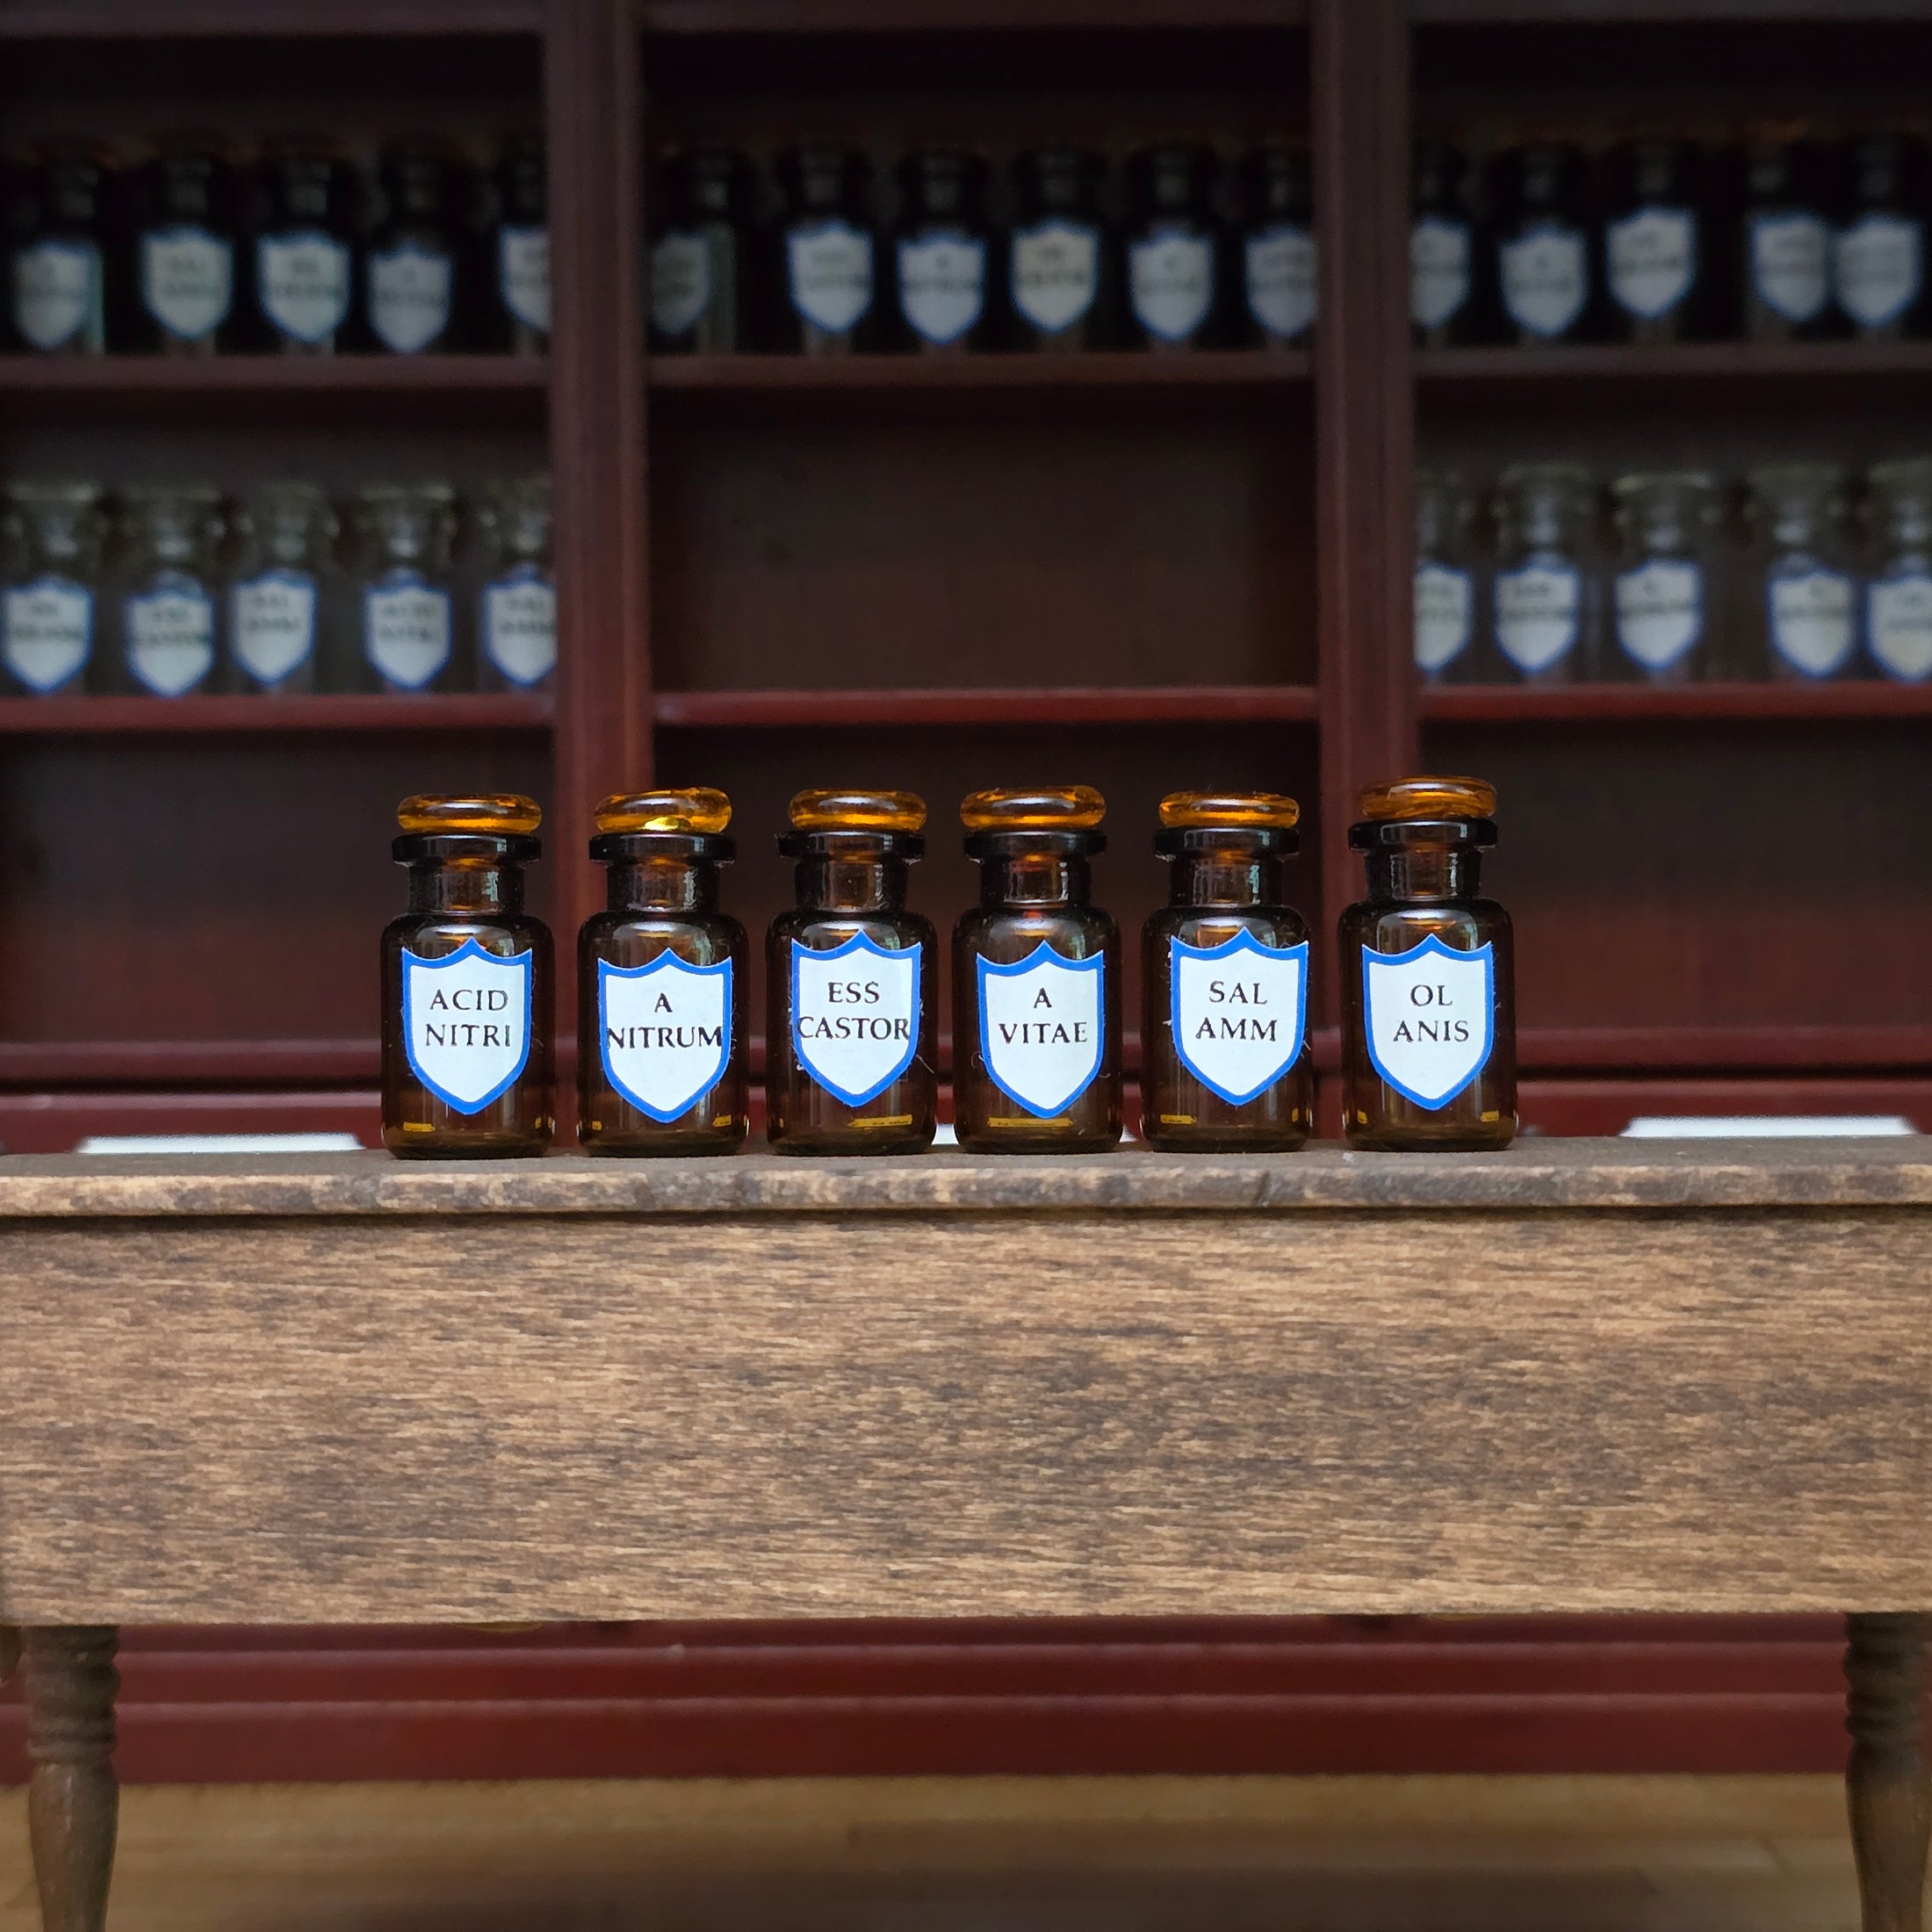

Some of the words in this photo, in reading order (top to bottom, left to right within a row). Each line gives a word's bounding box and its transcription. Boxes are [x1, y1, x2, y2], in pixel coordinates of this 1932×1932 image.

[429, 989, 508, 1012] ACID
[654, 992, 674, 1013] A
[827, 981, 880, 1004] ESS
[1034, 987, 1052, 1008] A
[1208, 980, 1268, 1005] SAL
[1410, 984, 1453, 1007] OL
[425, 1023, 510, 1048] NITRI
[606, 1025, 724, 1049] NITRUM
[797, 1016, 912, 1041] CASTOR
[998, 1021, 1088, 1044] VITAE
[1195, 1017, 1278, 1042] AMM
[1393, 1020, 1469, 1043] ANIS
